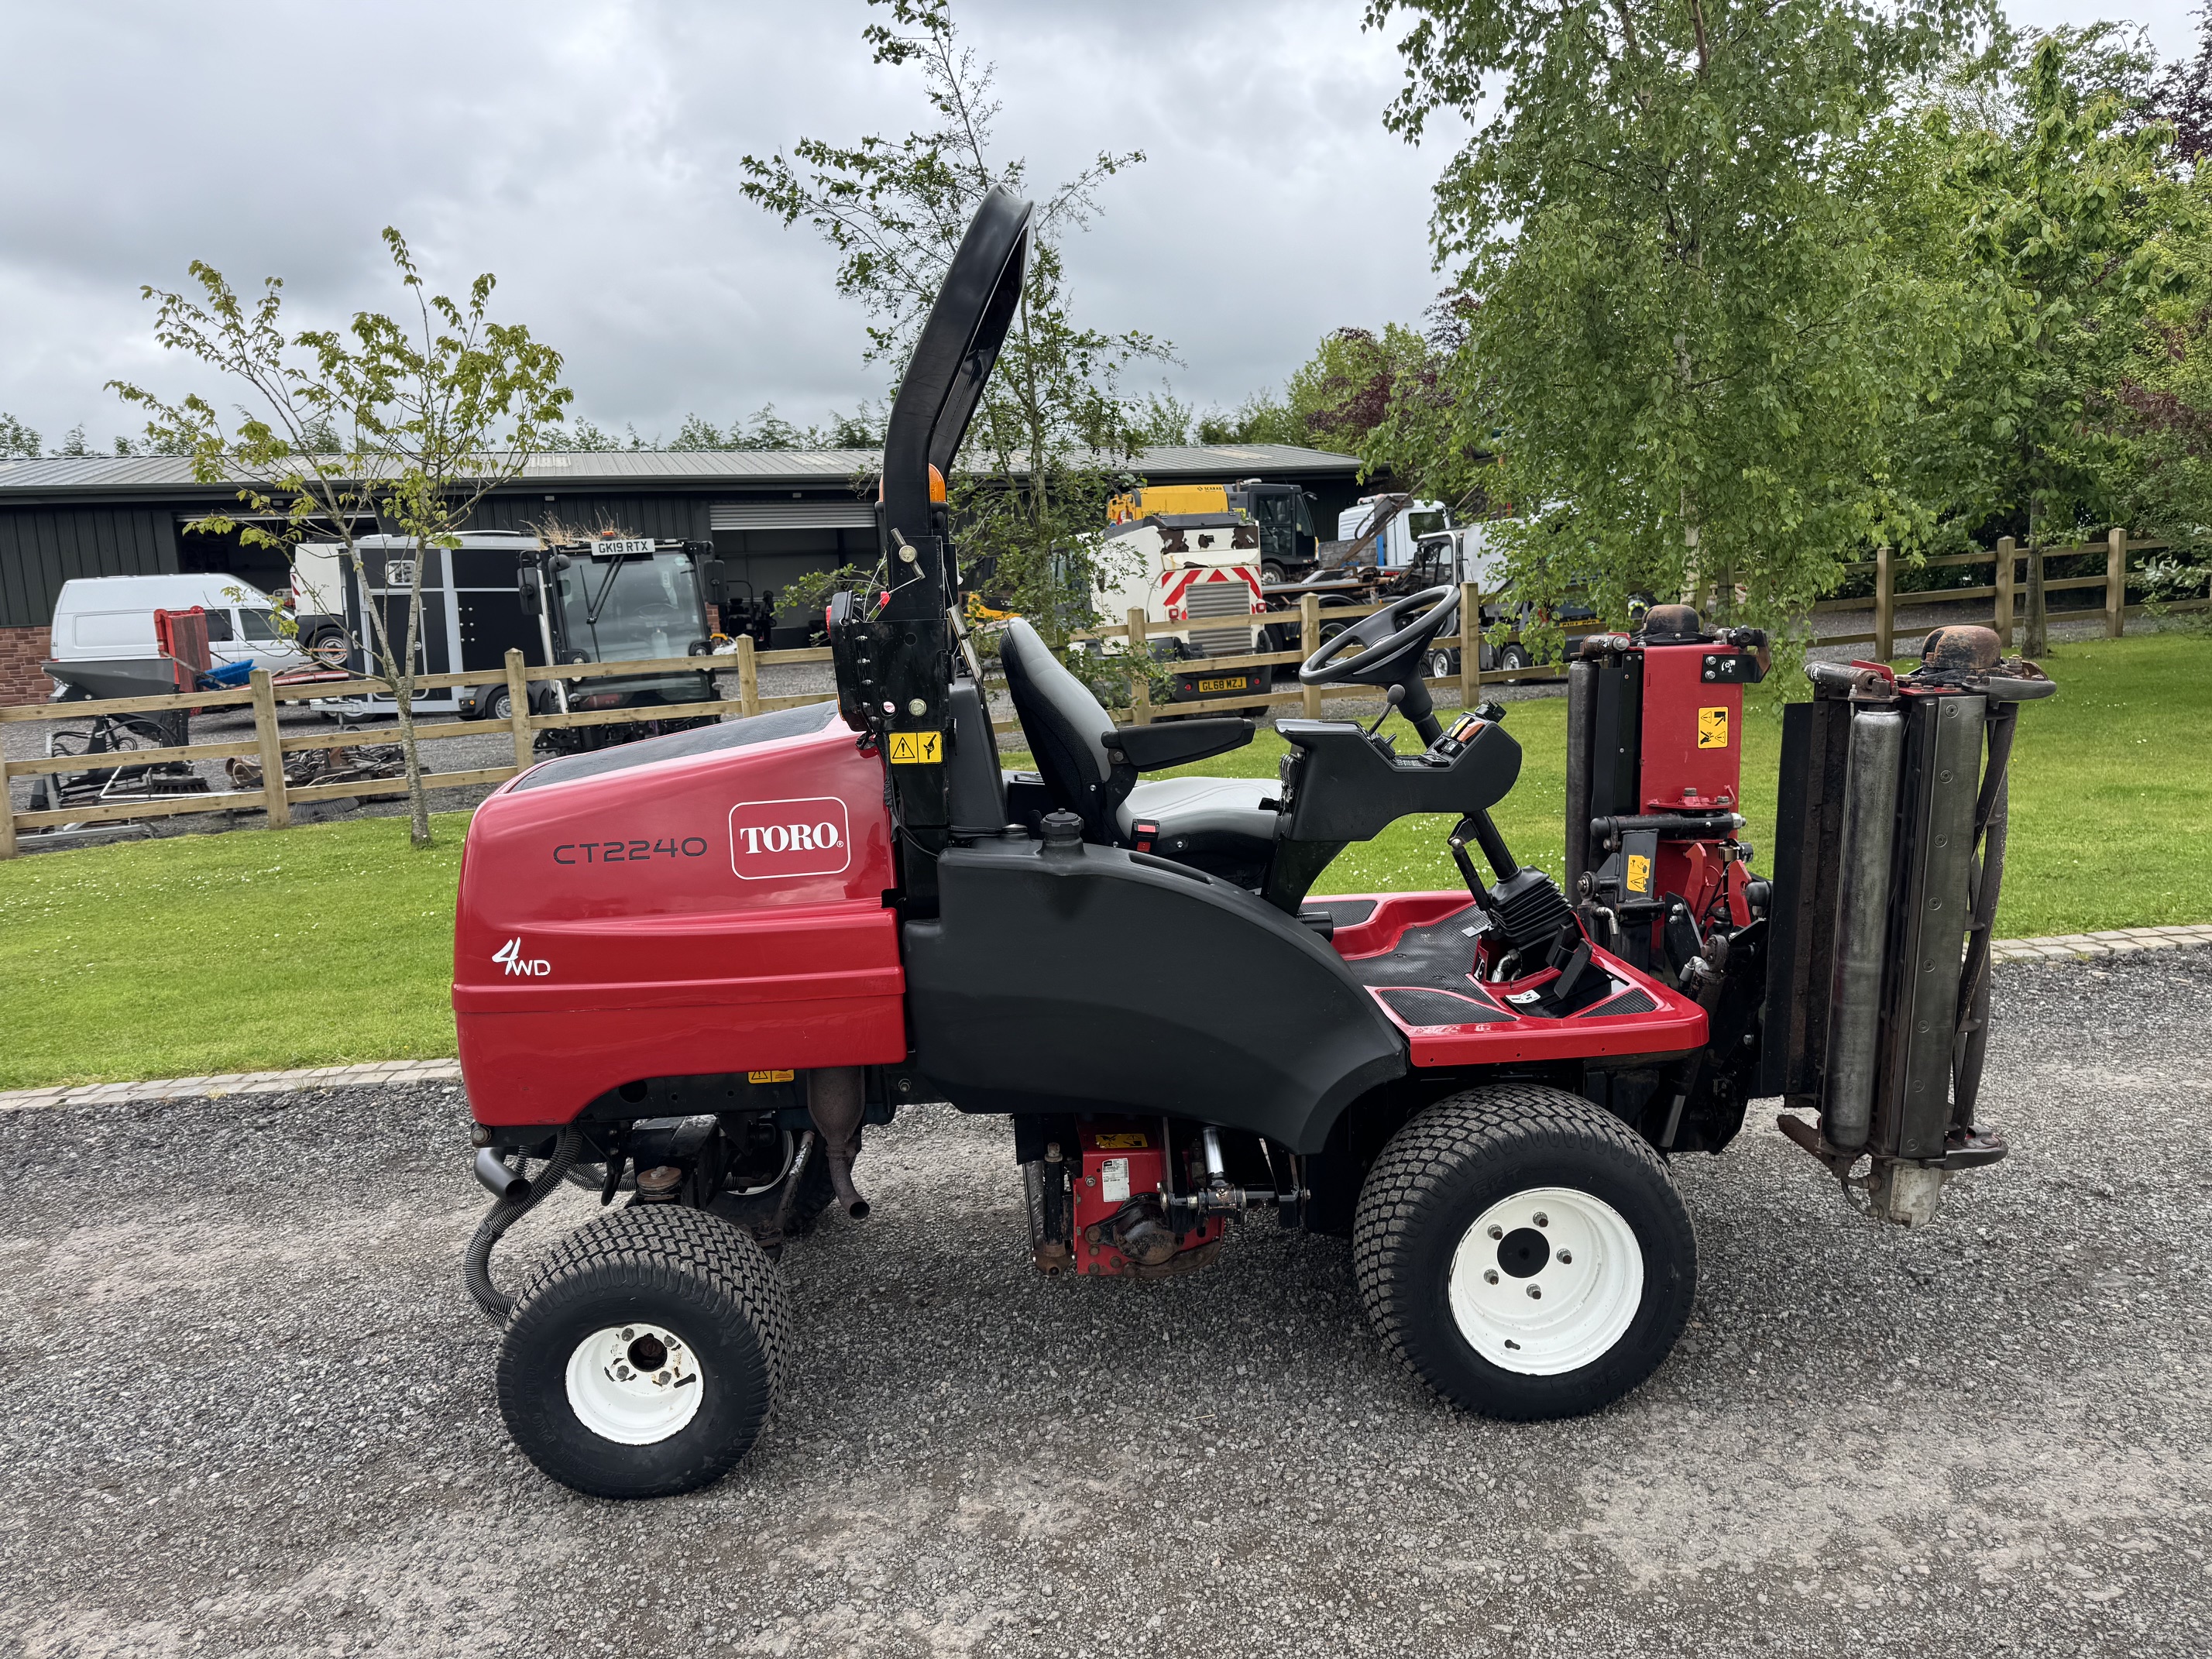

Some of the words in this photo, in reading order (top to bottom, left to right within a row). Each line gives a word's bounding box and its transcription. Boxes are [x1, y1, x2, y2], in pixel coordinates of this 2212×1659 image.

[599, 543, 623, 553] GK19
[626, 541, 648, 552] RTX
[1202, 681, 1224, 691] GL68
[1226, 678, 1243, 689] MZJ
[553, 836, 708, 864] CT2240
[491, 936, 551, 976] 4WD
